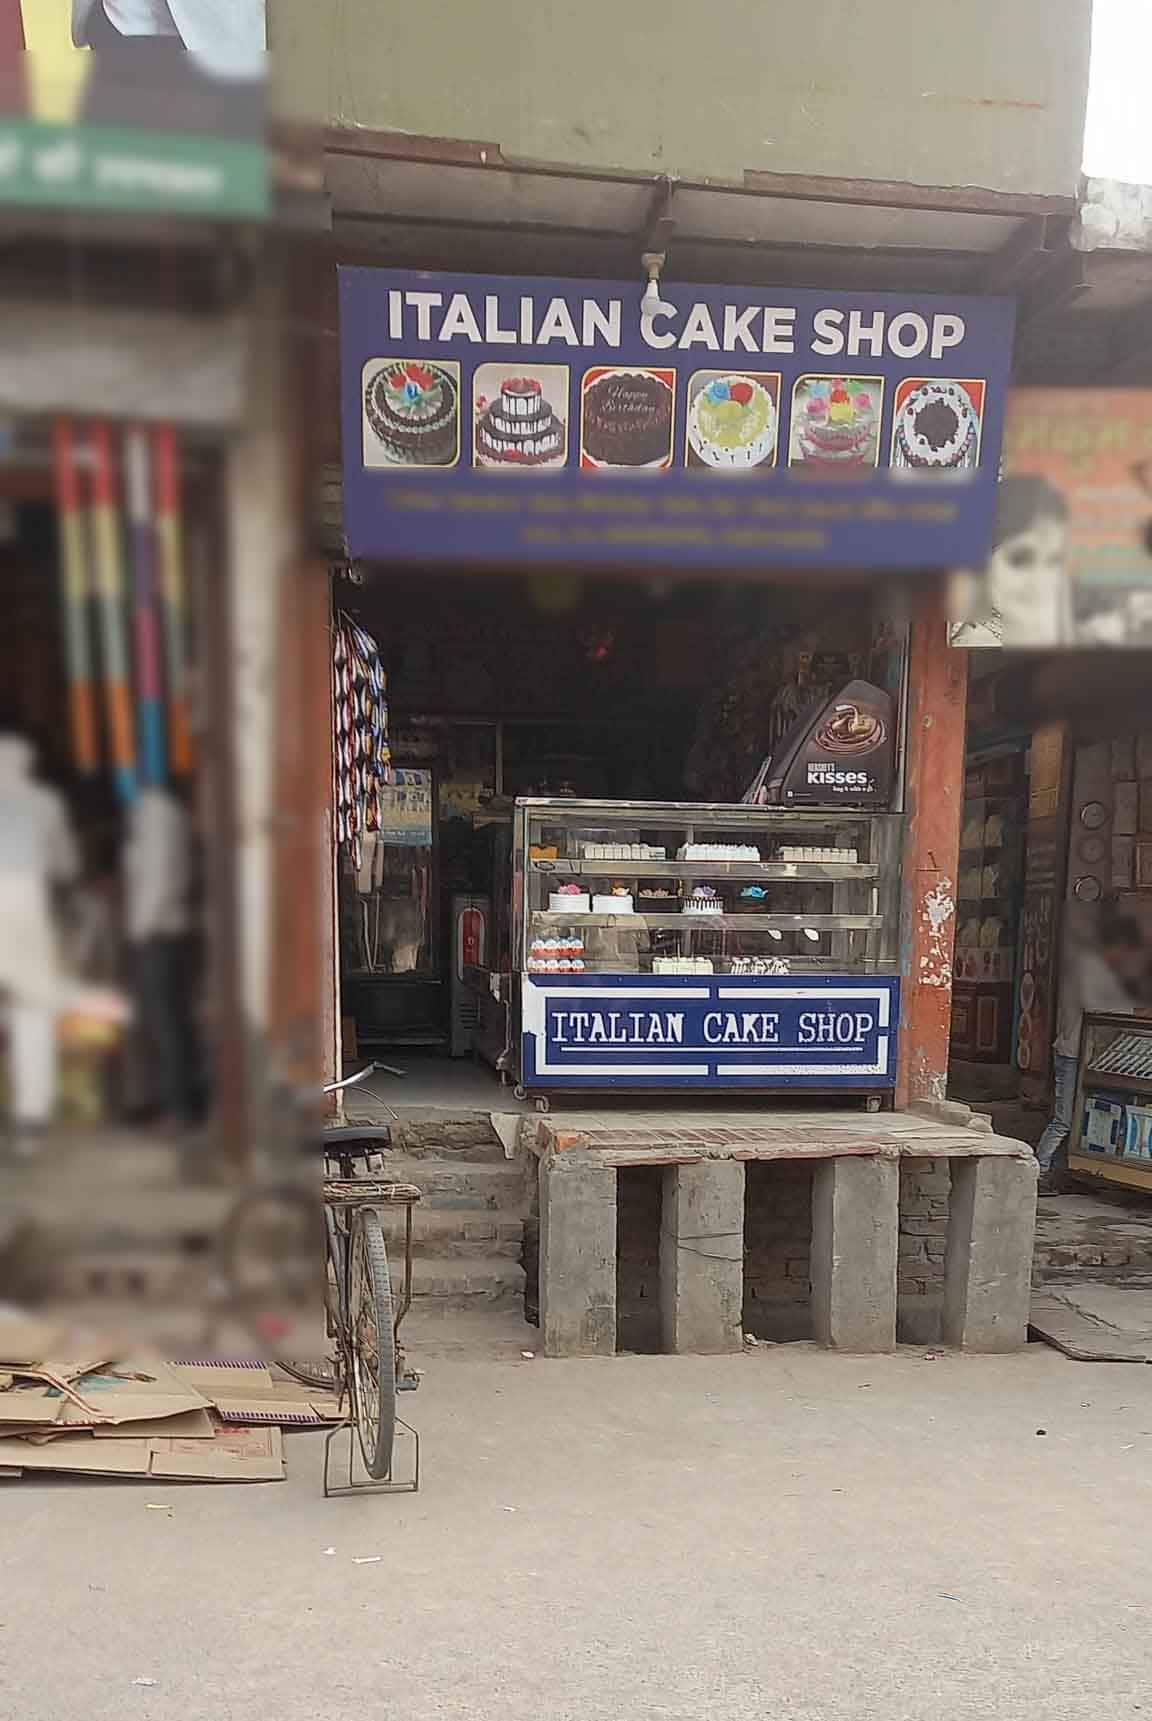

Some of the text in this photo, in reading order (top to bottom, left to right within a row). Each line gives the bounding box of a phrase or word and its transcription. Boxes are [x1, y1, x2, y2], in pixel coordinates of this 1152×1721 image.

[389, 290, 965, 359] ITALIAN CAKE SHOP
[552, 1012, 874, 1043] ITALIAN CAKE SHOP
